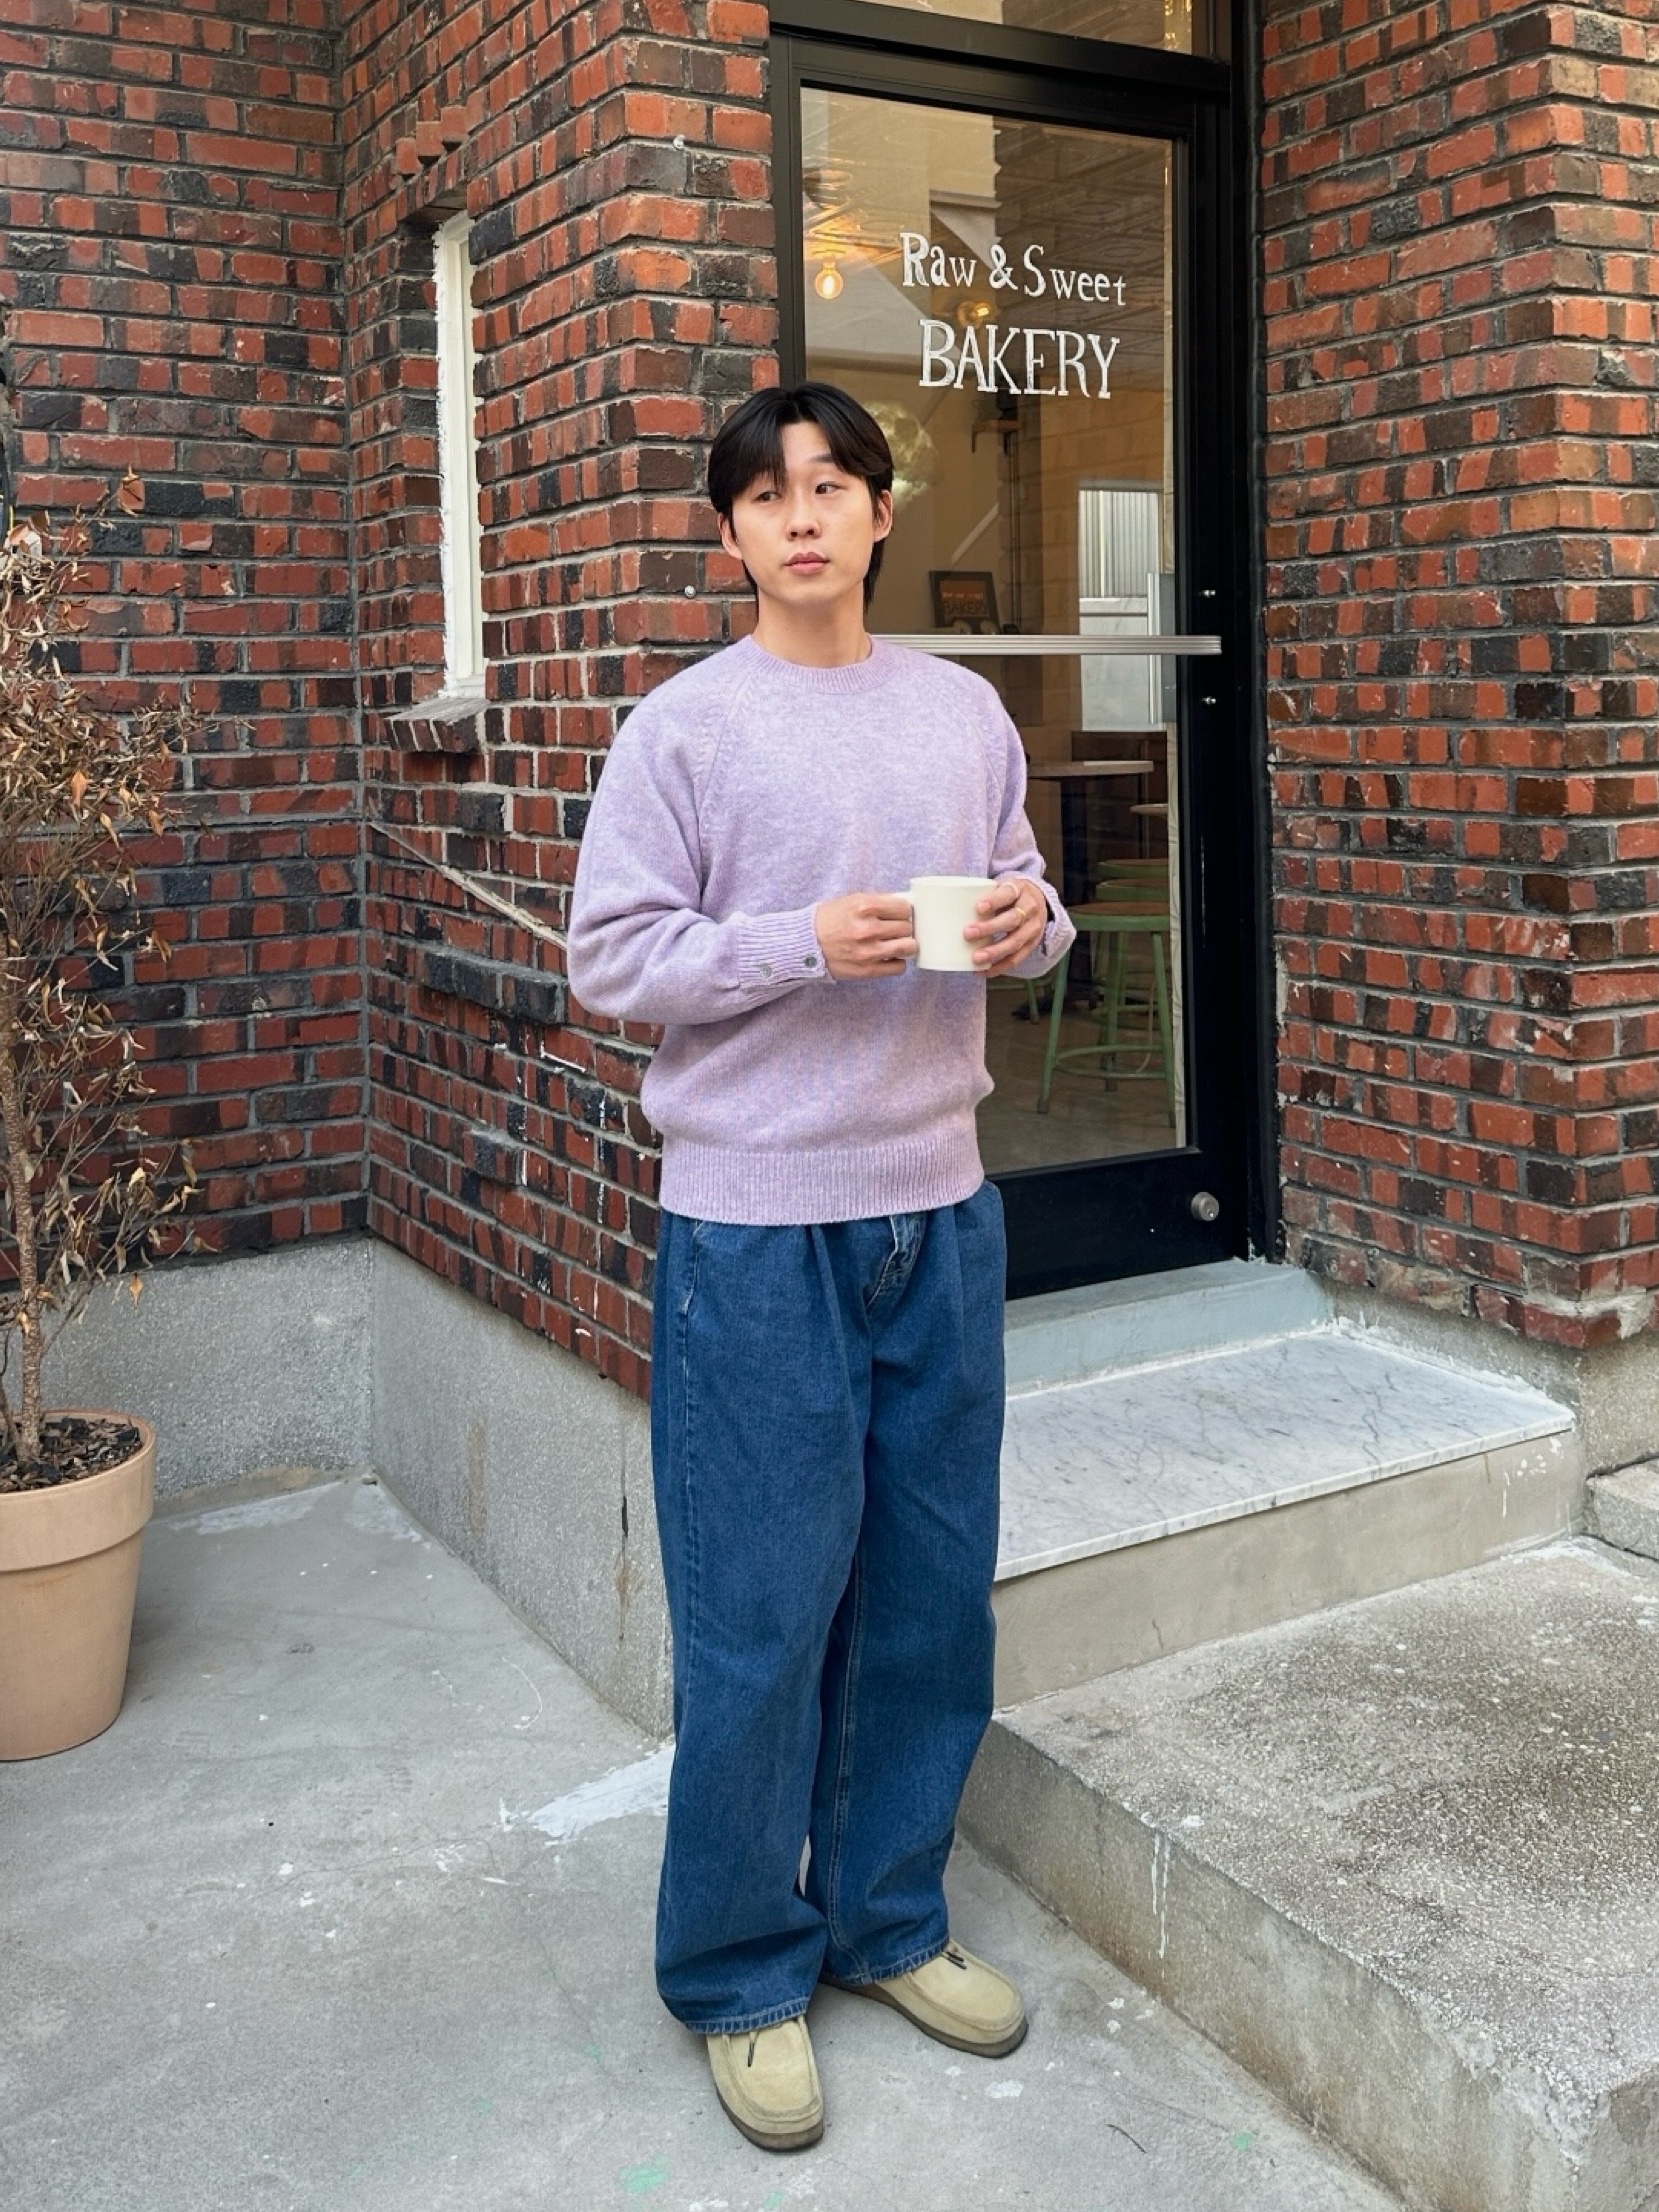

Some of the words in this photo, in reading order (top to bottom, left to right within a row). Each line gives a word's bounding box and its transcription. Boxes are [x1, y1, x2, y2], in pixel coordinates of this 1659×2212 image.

[900, 232, 977, 288] Raw
[988, 244, 1018, 290] &
[1023, 244, 1127, 306] Sweet
[918, 318, 1121, 399] BAKERY
